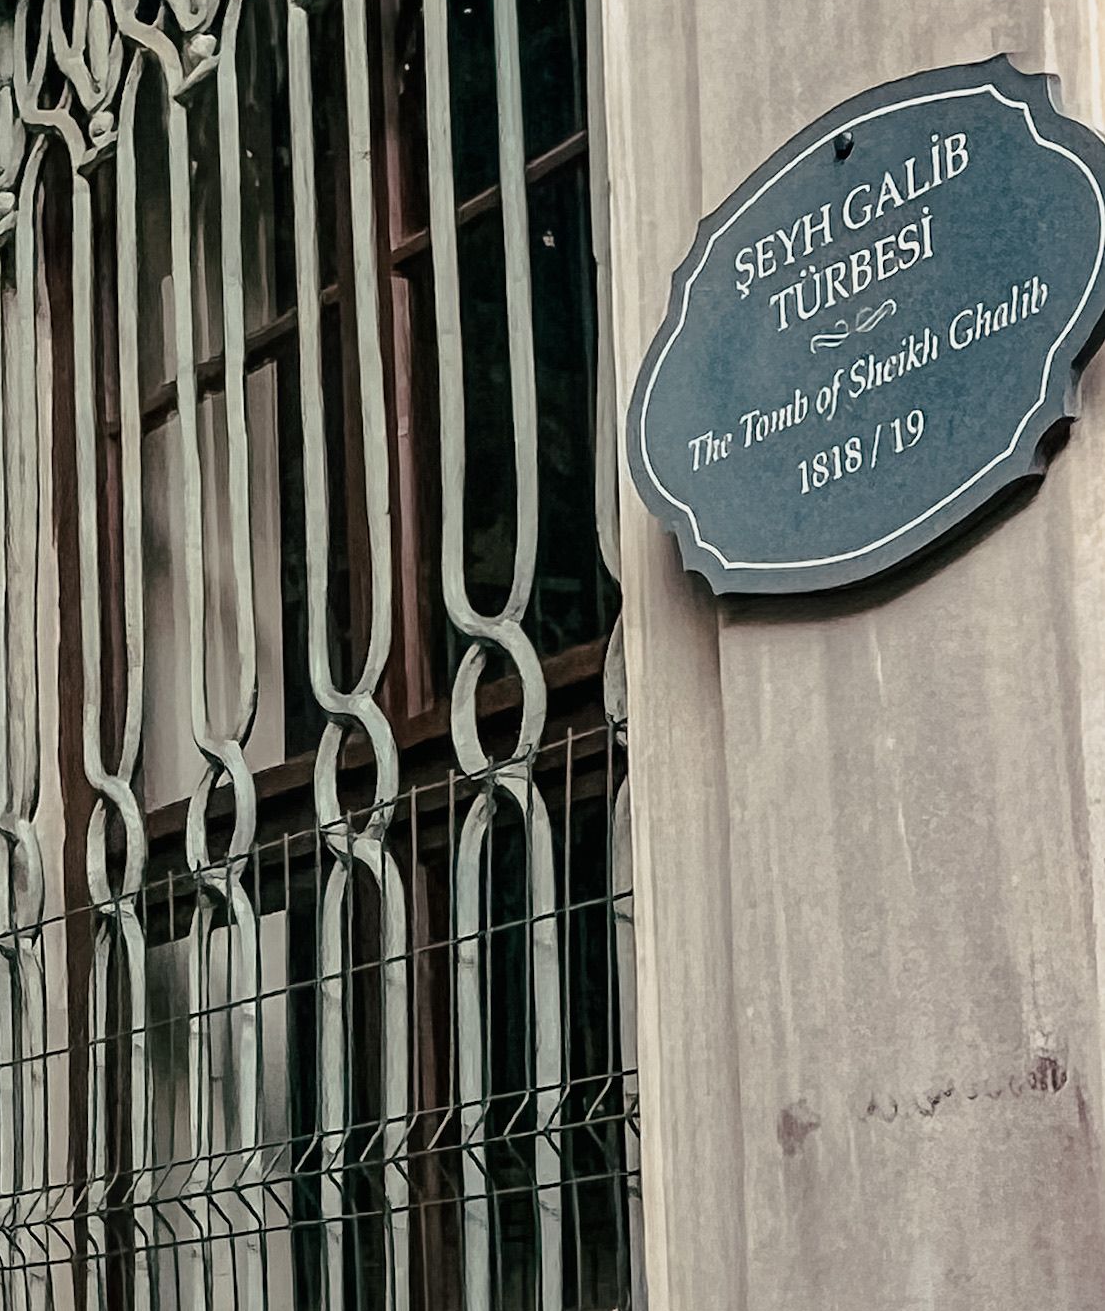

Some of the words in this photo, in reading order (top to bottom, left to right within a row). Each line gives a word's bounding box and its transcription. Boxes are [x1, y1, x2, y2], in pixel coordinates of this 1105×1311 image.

[735, 203, 834, 300] ŞEYH
[842, 132, 970, 230] GALİB
[769, 206, 934, 332] TÜRBESİ
[687, 430, 733, 472] The
[739, 388, 808, 448] Tomb
[815, 368, 845, 422] of
[848, 327, 939, 399] Sheikh
[949, 276, 1049, 350] Ghalib
